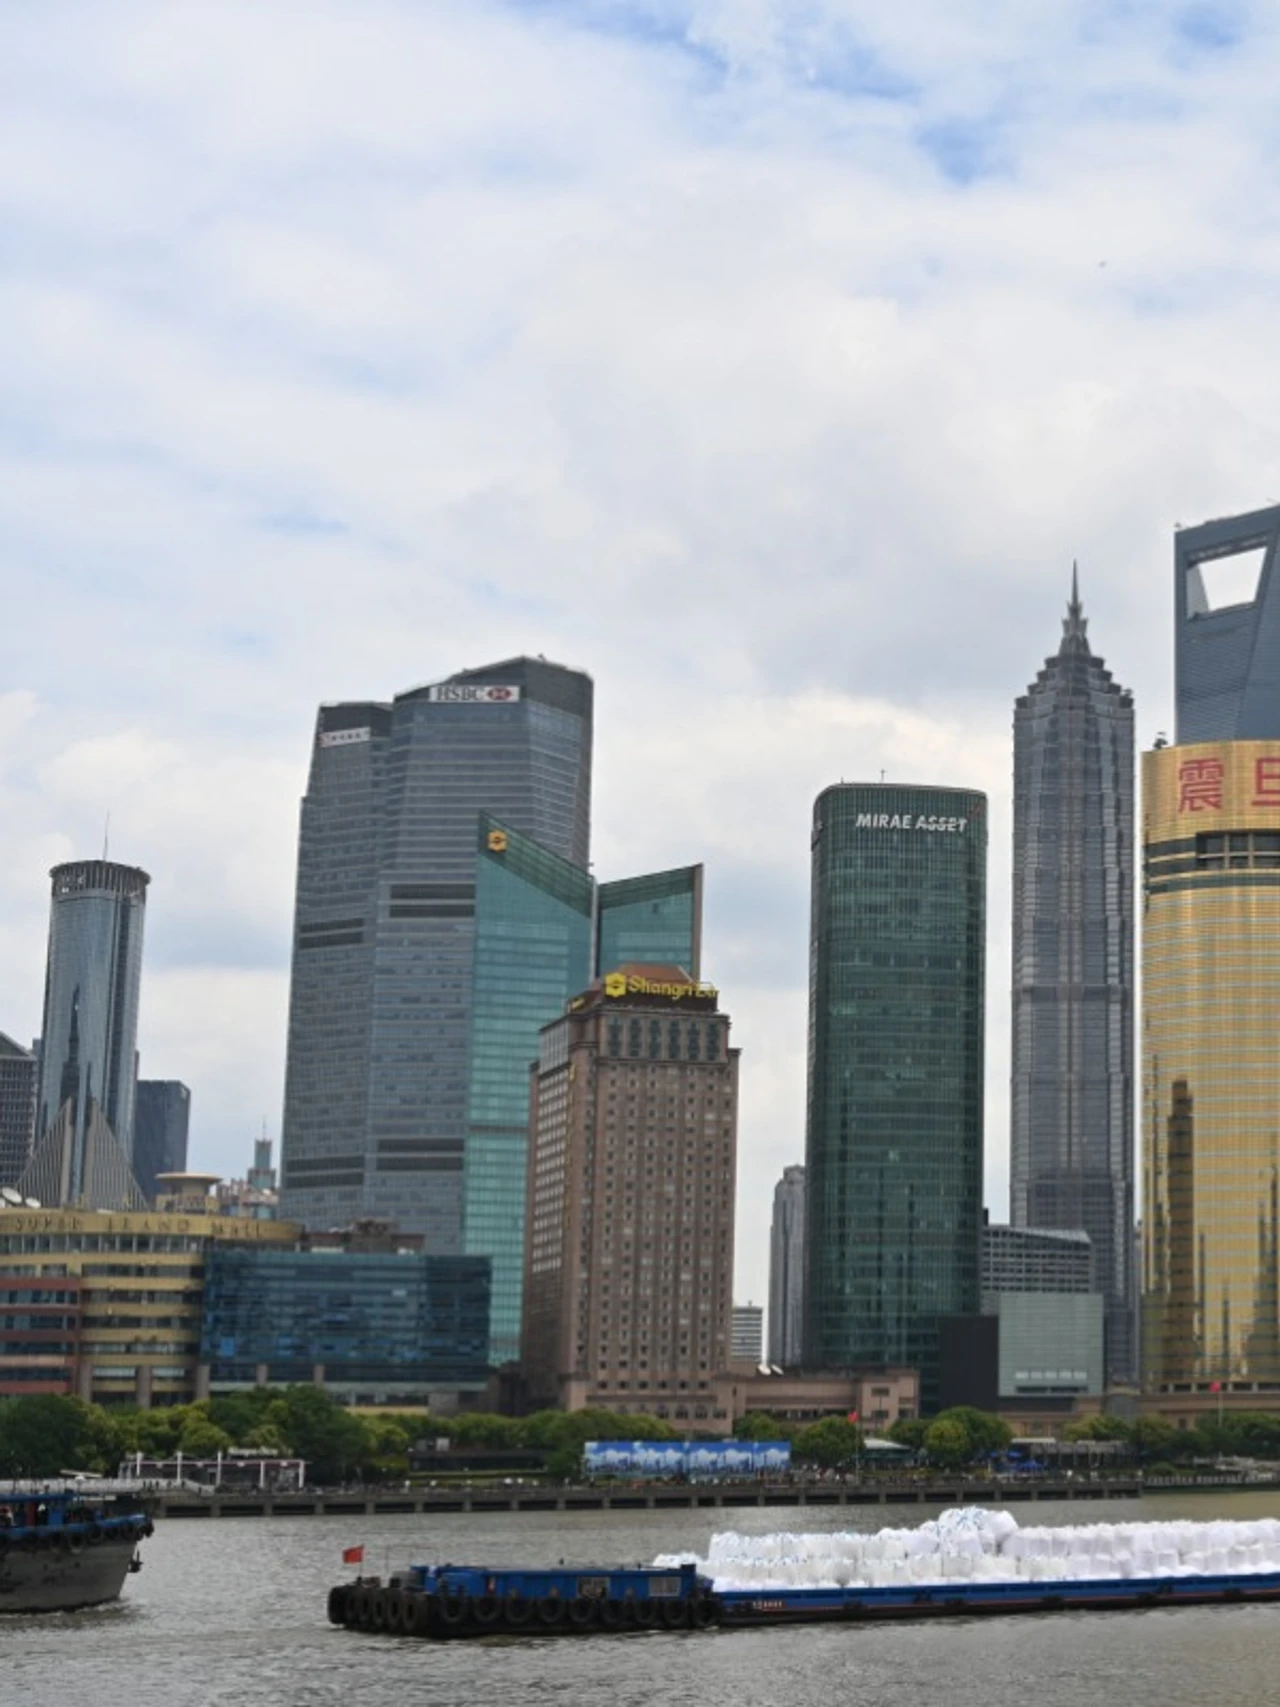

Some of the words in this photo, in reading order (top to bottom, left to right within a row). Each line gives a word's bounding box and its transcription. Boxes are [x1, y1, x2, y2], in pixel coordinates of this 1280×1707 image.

[436, 685, 482, 701] HSBC
[856, 813, 912, 829] MIRAE
[915, 815, 968, 832] ASSET
